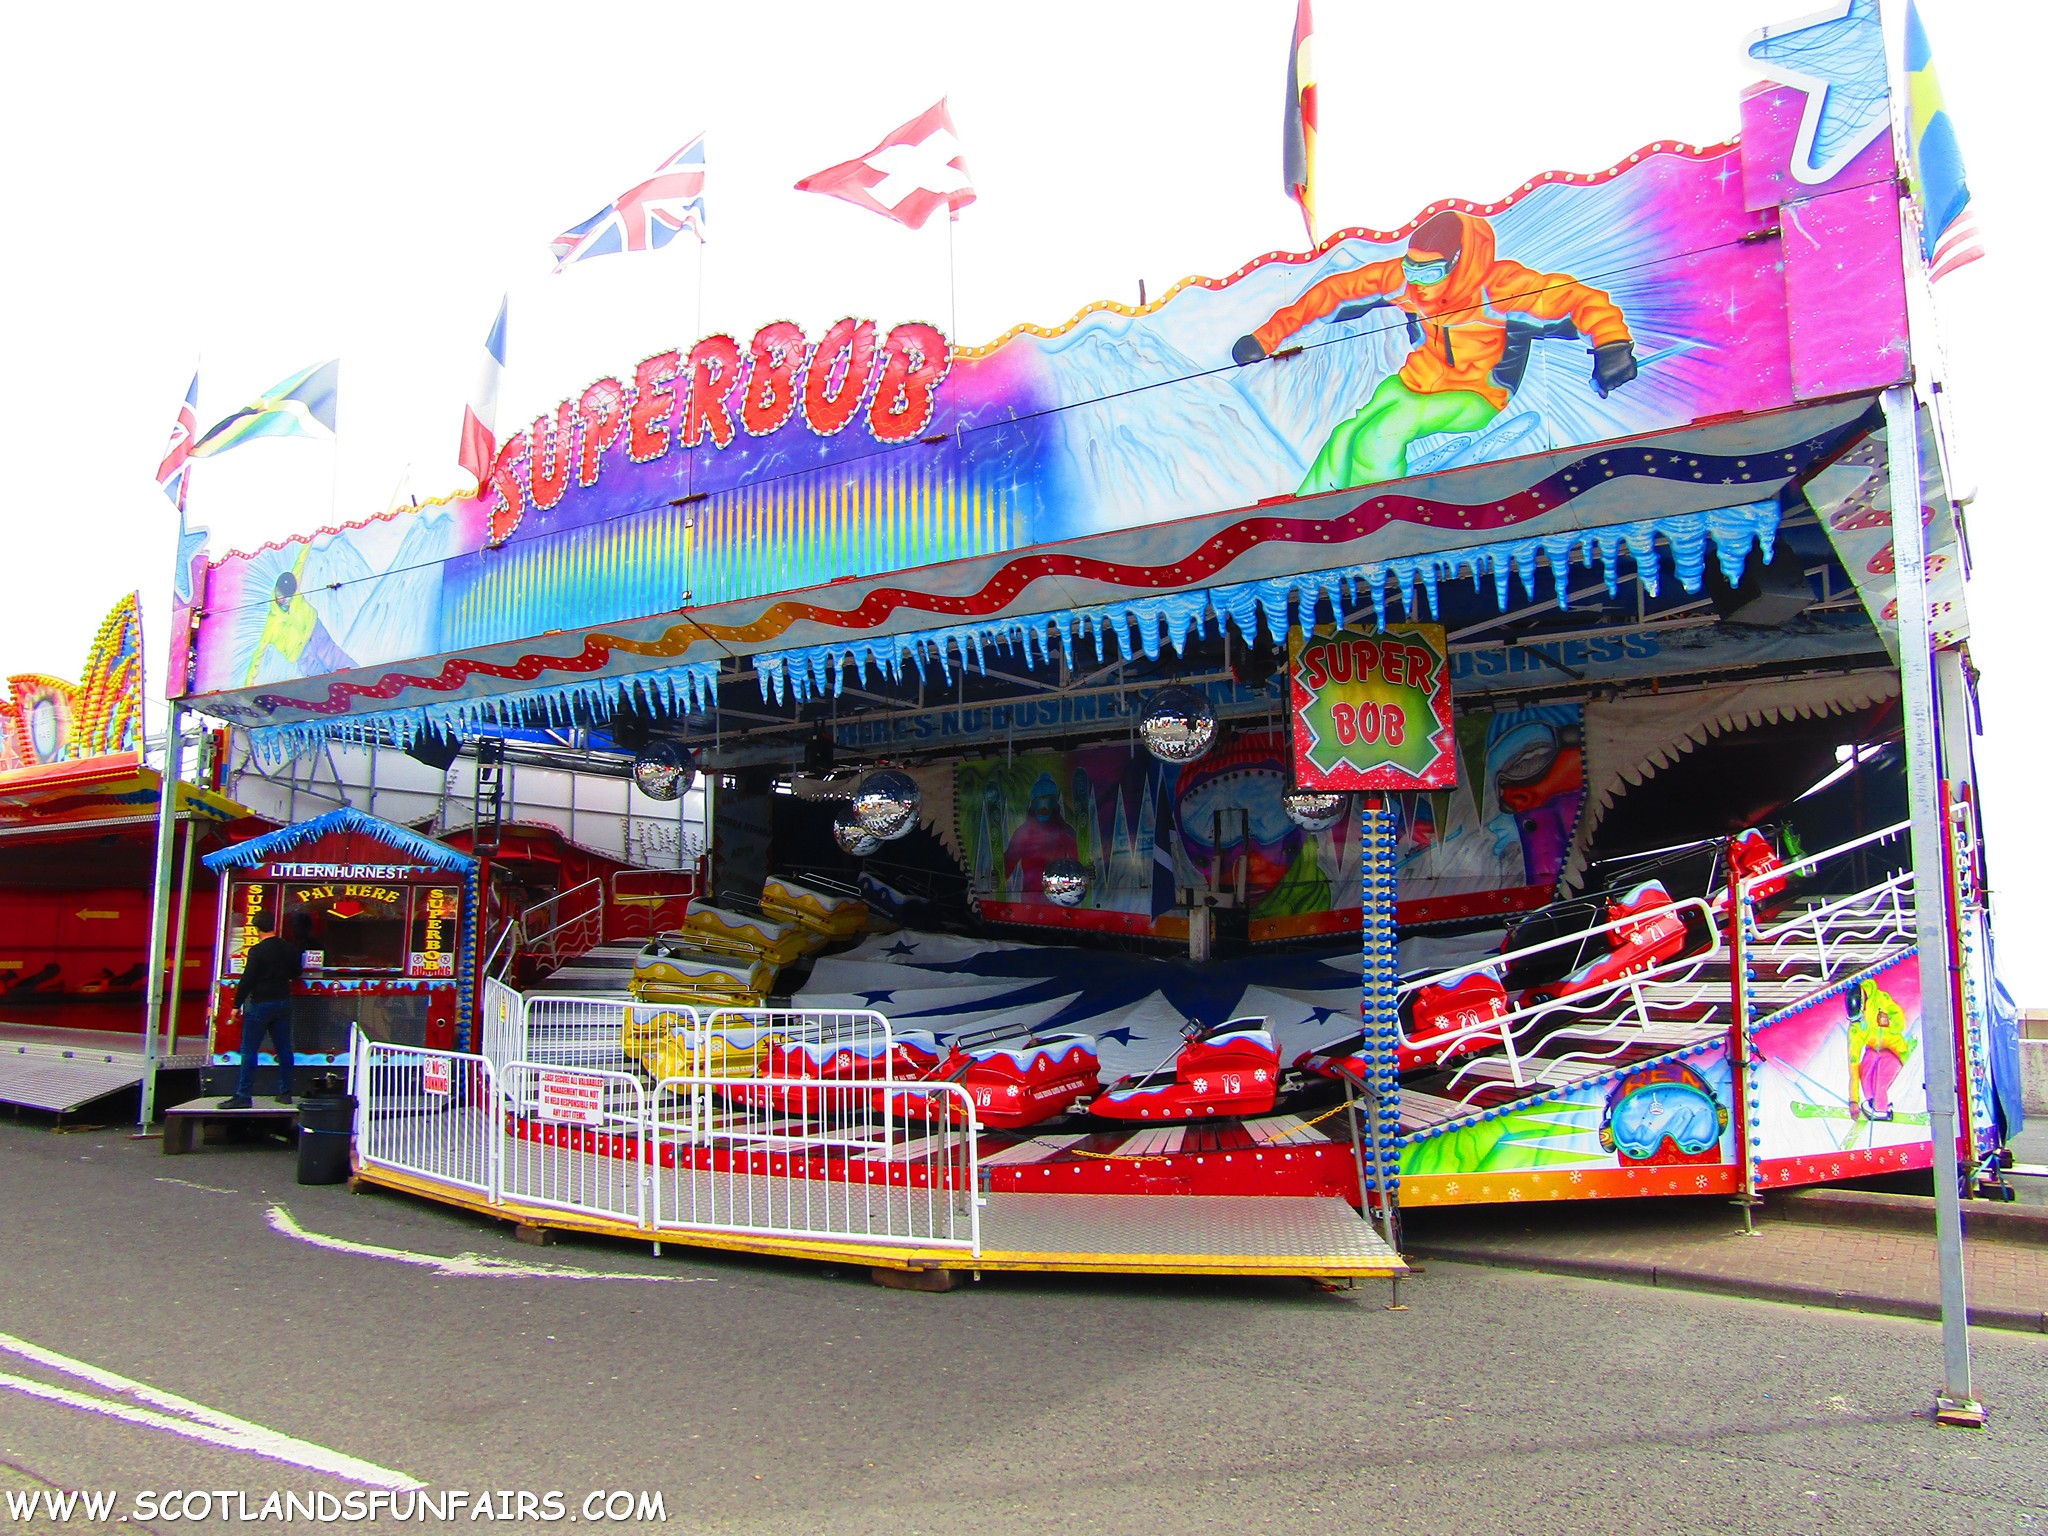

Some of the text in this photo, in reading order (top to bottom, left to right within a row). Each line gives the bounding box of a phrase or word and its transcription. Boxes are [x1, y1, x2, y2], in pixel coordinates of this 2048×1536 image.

[486, 314, 954, 545] SUPERBOB
[1302, 639, 1434, 695] SUPER
[1451, 631, 1660, 679] USINESS
[1330, 700, 1406, 747] BOB
[271, 865, 408, 879] LITLIERNHURNEST.
[297, 885, 401, 904] PAY HERE
[424, 889, 445, 970] SUPERBOB
[975, 1086, 993, 1107] 18
[1221, 1073, 1241, 1094] 19
